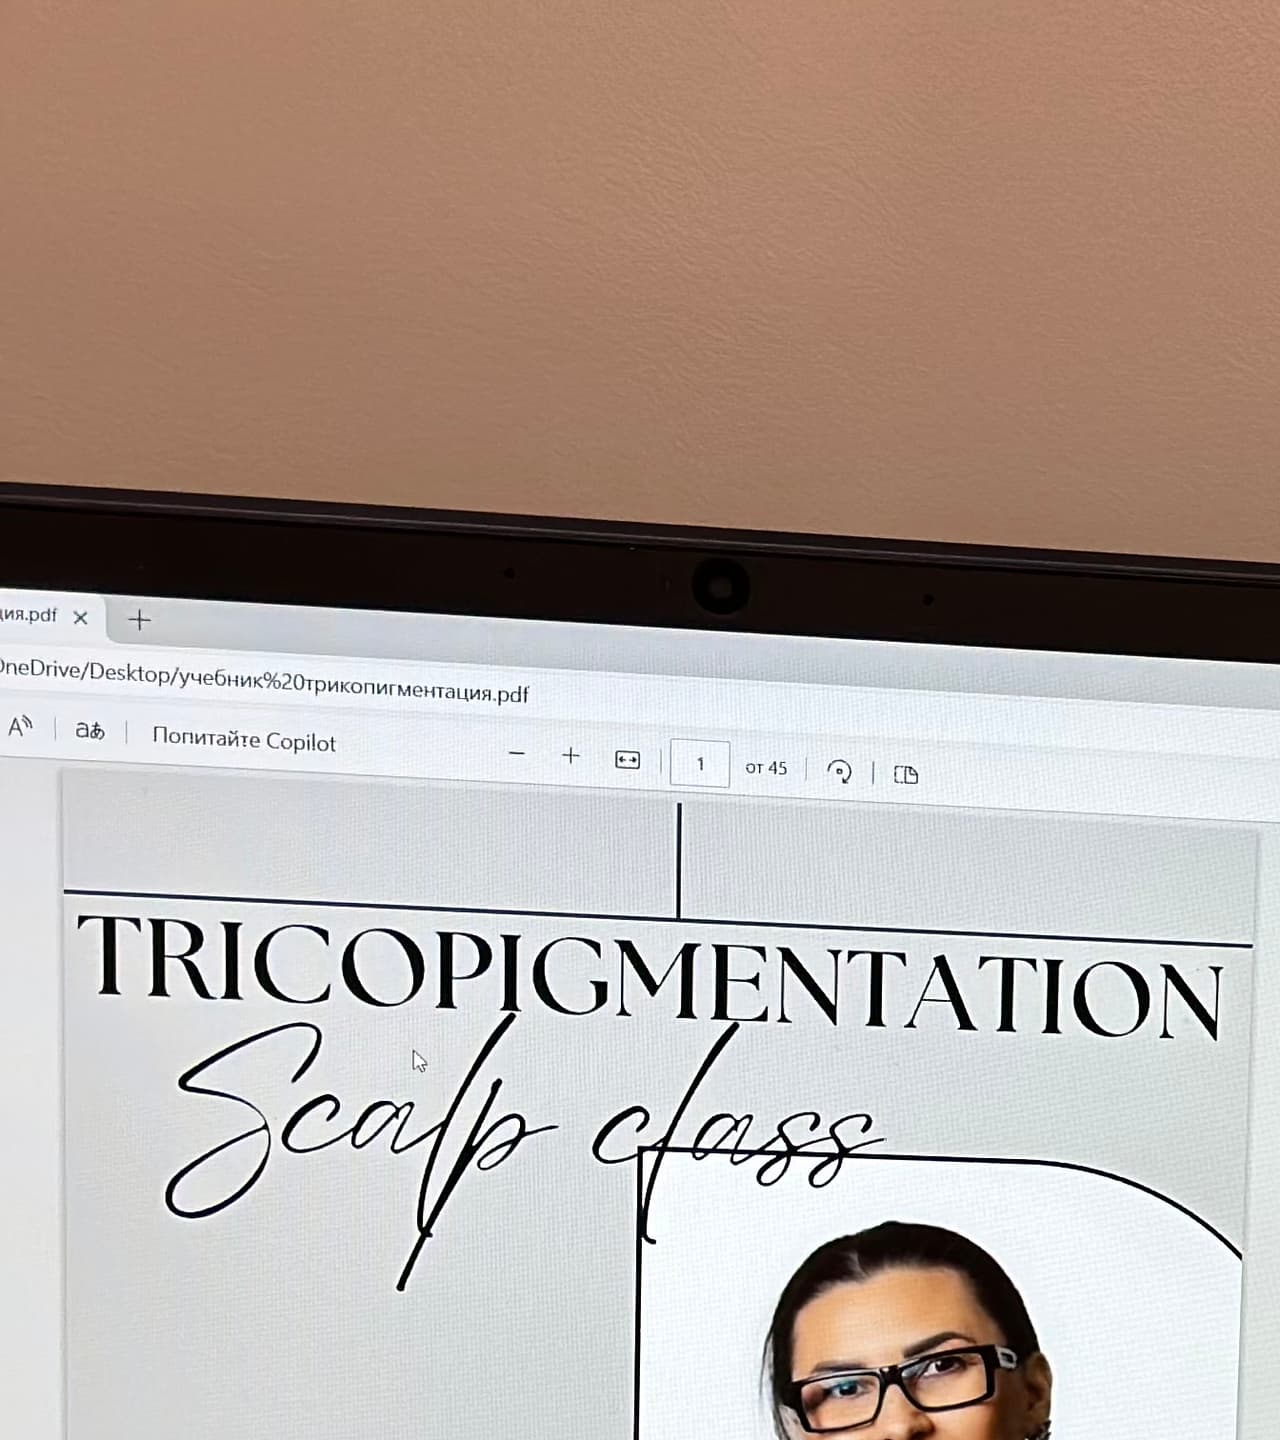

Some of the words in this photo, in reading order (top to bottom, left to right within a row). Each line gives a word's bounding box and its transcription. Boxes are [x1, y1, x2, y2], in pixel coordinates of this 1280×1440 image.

[153, 725, 261, 748] Попитайте
[266, 732, 337, 755] Copilot
[697, 756, 704, 771] 1
[768, 761, 788, 776] 45
[77, 914, 1225, 1042] TRICOPIGMENTATION
[165, 1012, 560, 1293] Scalp
[591, 1020, 887, 1245] class
